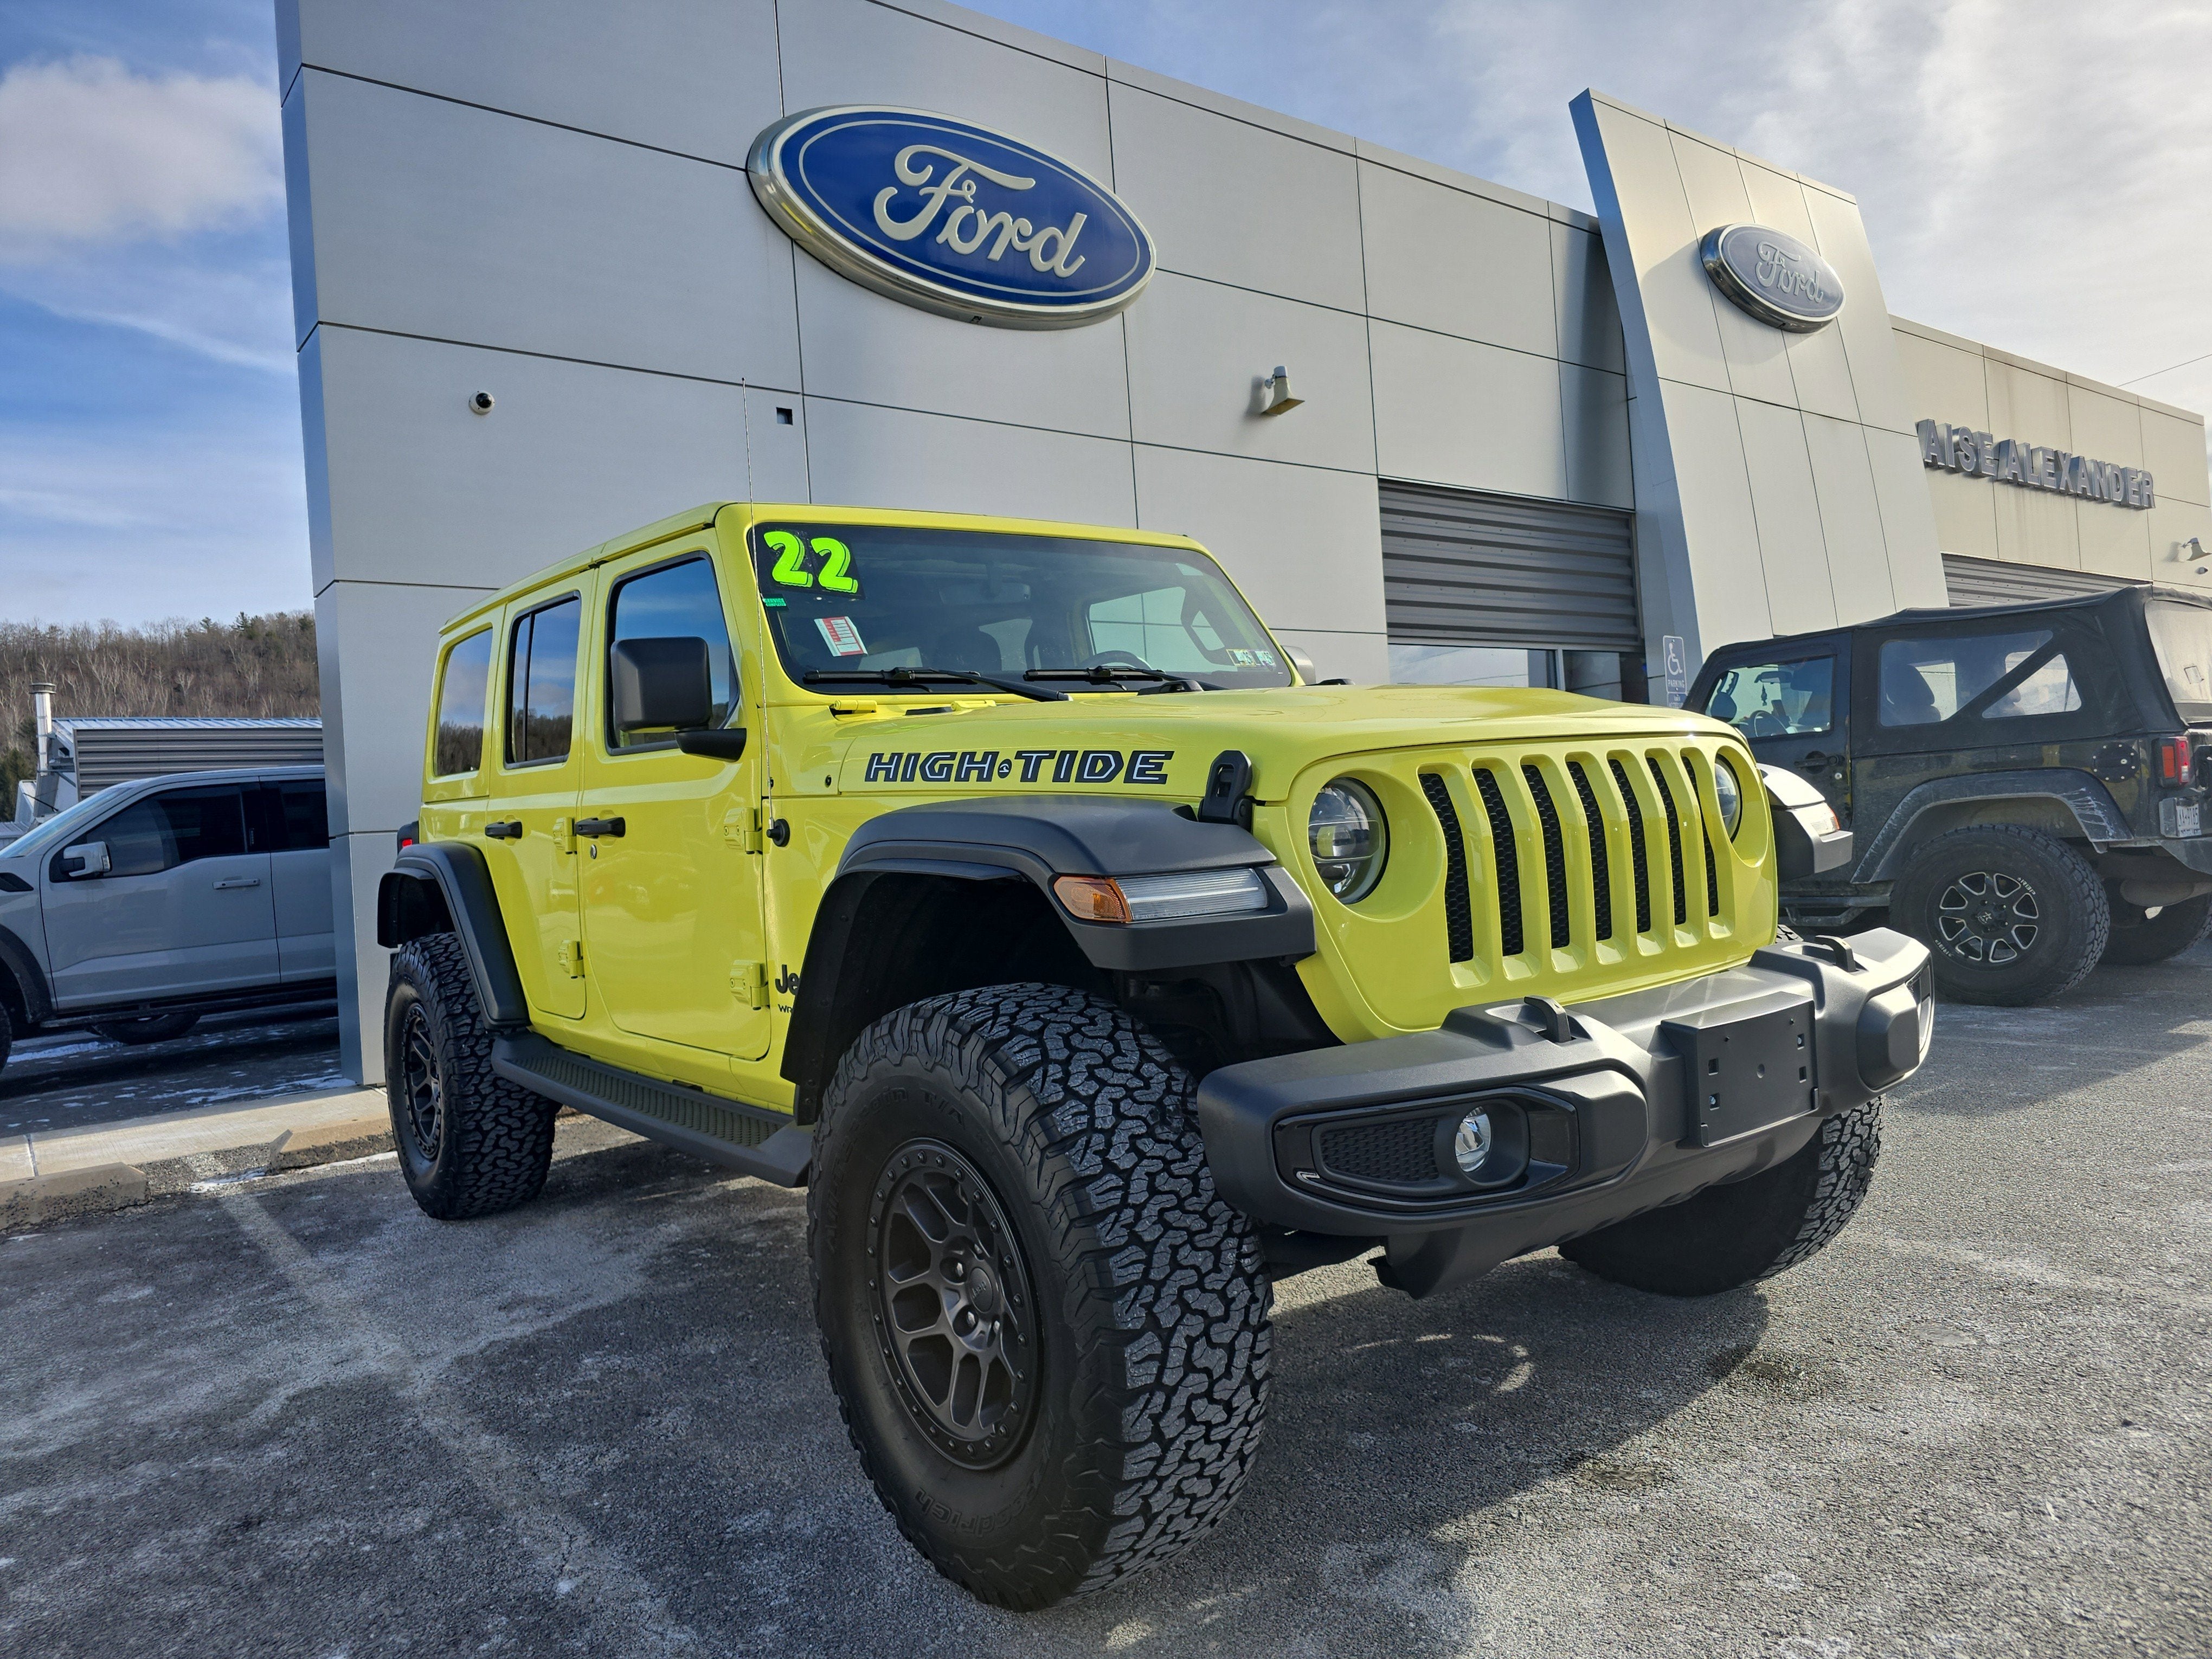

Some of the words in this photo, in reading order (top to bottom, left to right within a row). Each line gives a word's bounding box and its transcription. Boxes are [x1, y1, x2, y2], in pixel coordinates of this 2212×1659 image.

[873, 144, 1088, 279] Ford
[1754, 241, 1824, 303] Ford
[1915, 419, 1997, 477] AISE
[1997, 439, 2157, 510] ALEXANDER
[763, 530, 859, 594] 22
[1668, 679, 1685, 688] PARKING
[864, 751, 1000, 782] HIGH
[1014, 750, 1175, 785] TIDE
[2020, 879, 2036, 895] RBP
[775, 964, 801, 996] Je
